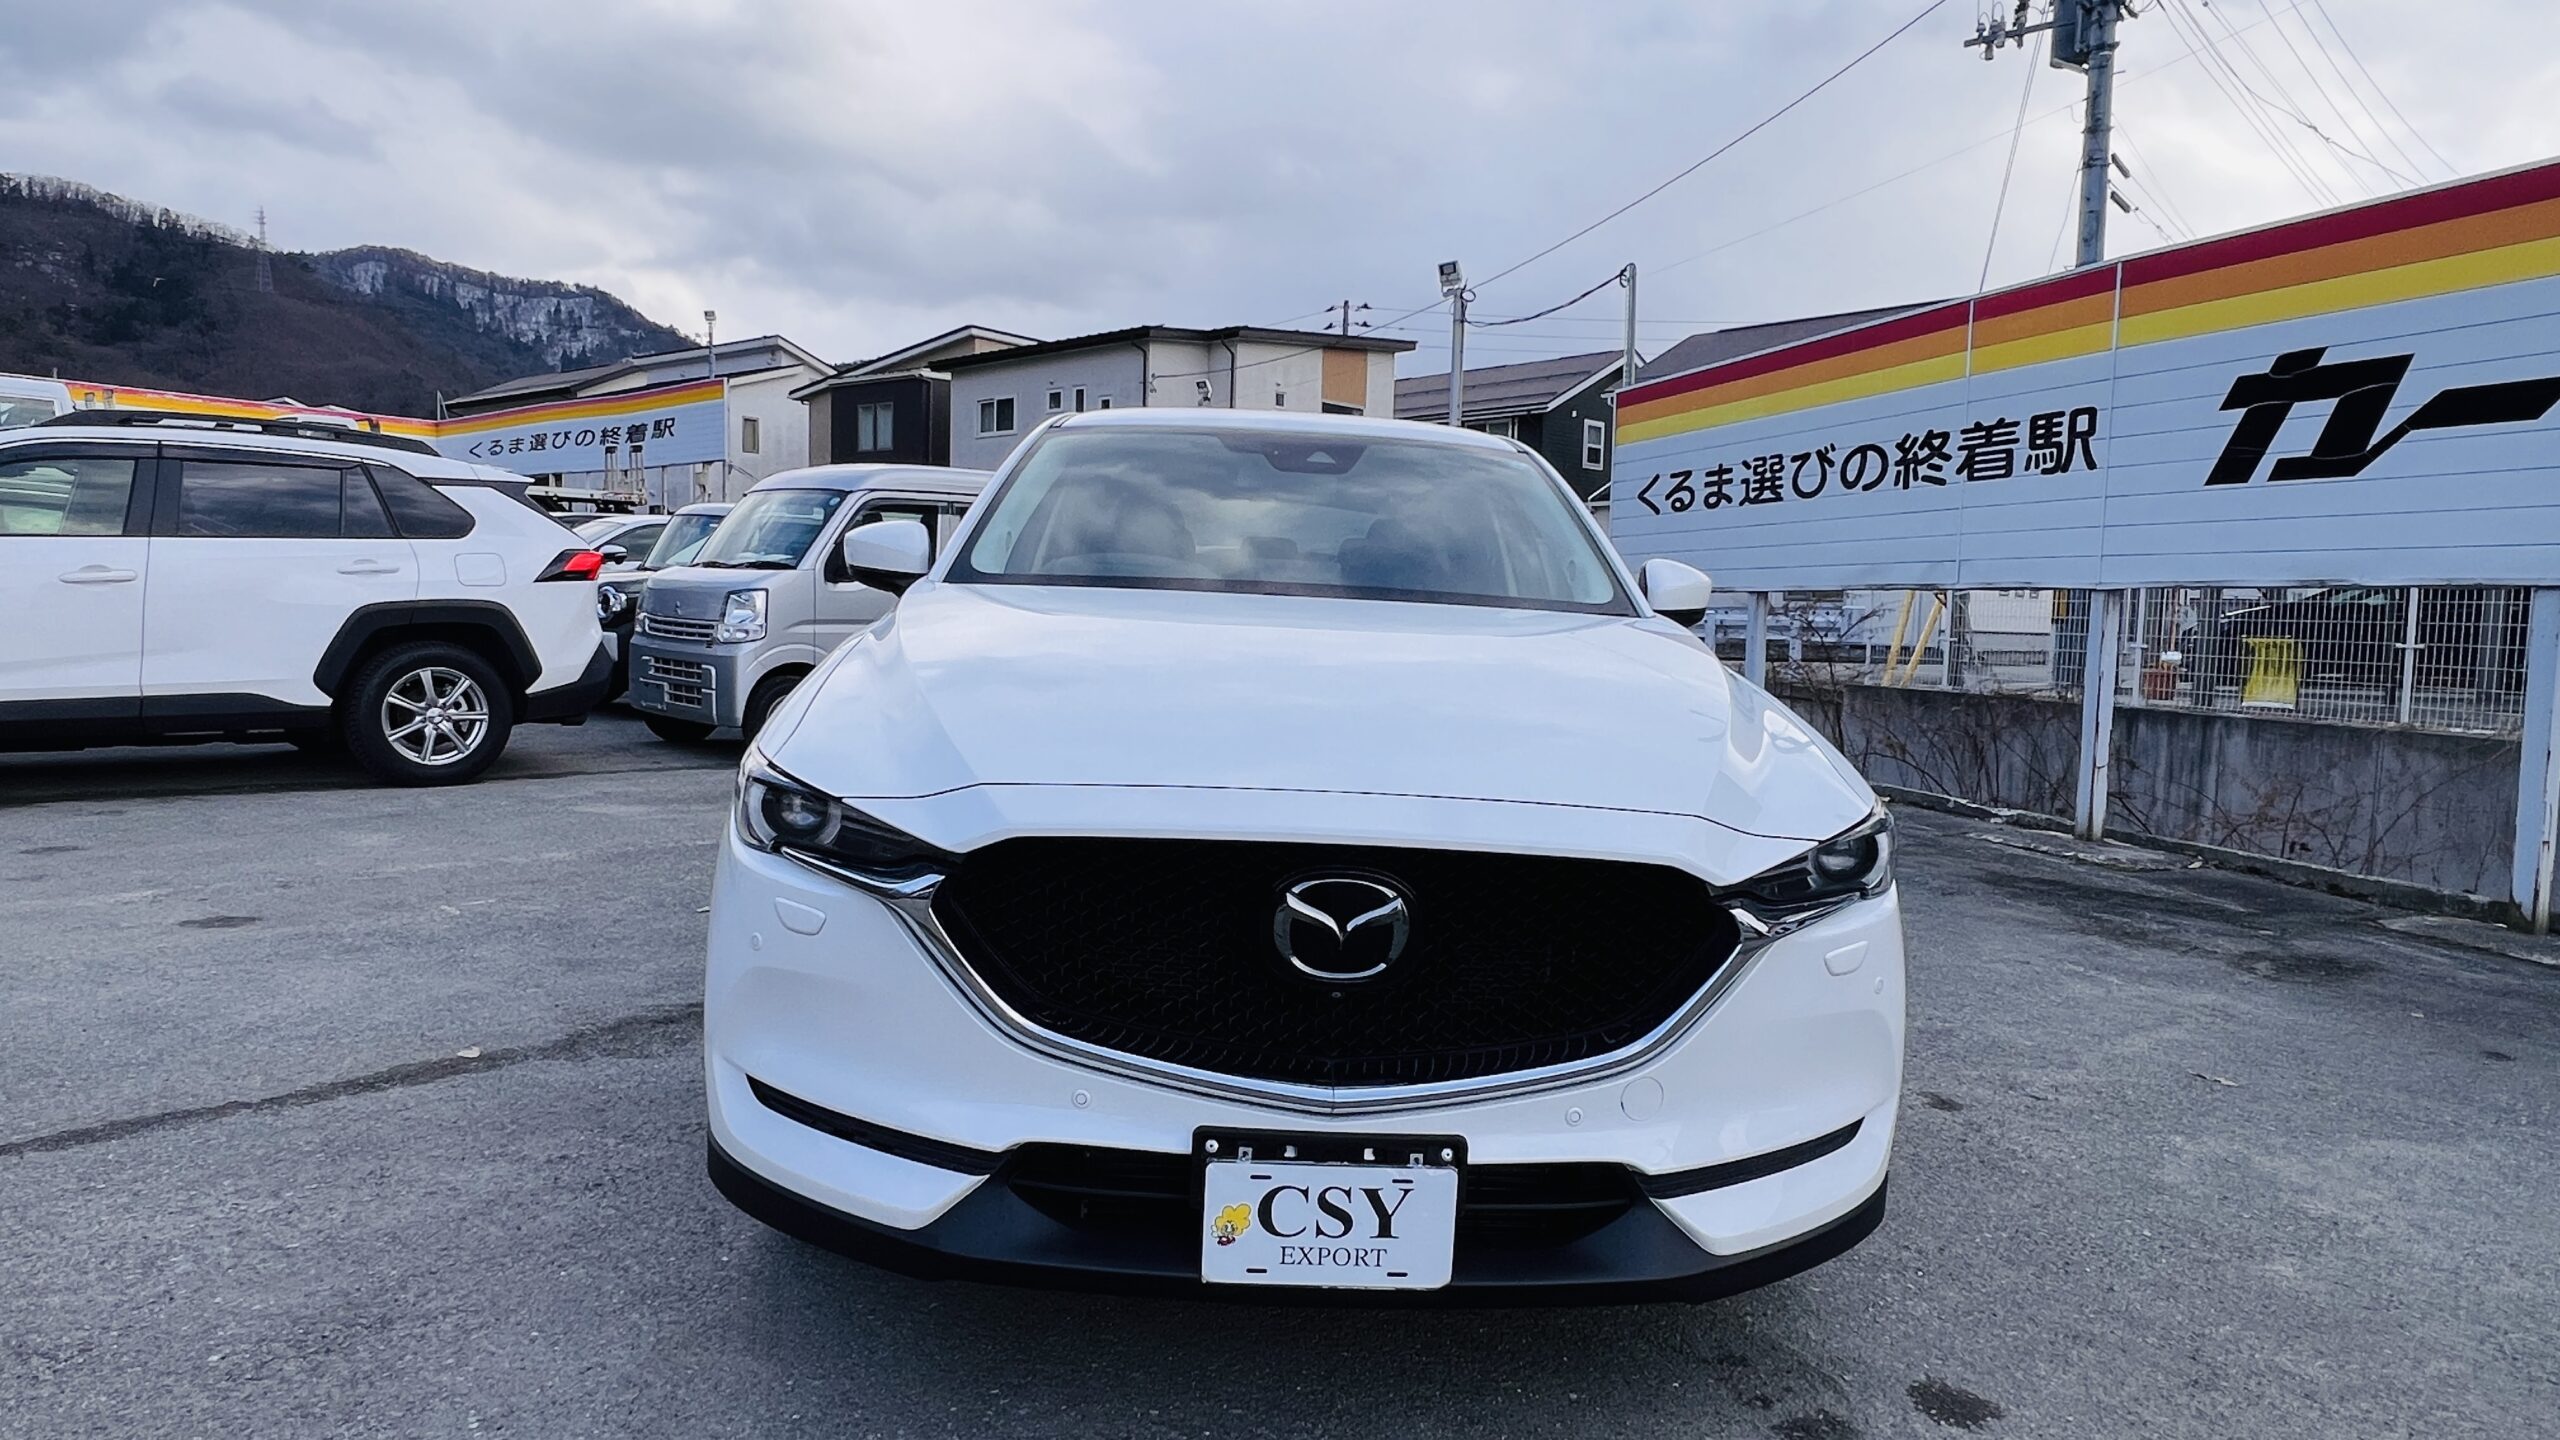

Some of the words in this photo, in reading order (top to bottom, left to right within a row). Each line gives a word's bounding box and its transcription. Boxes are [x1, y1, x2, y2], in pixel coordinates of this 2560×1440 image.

[468, 417, 676, 459] くるま選びの終着駅
[1636, 406, 2098, 515] くるま選びの終着駅
[1257, 1185, 1415, 1239] CSY
[1279, 1245, 1388, 1268] EXPORT
